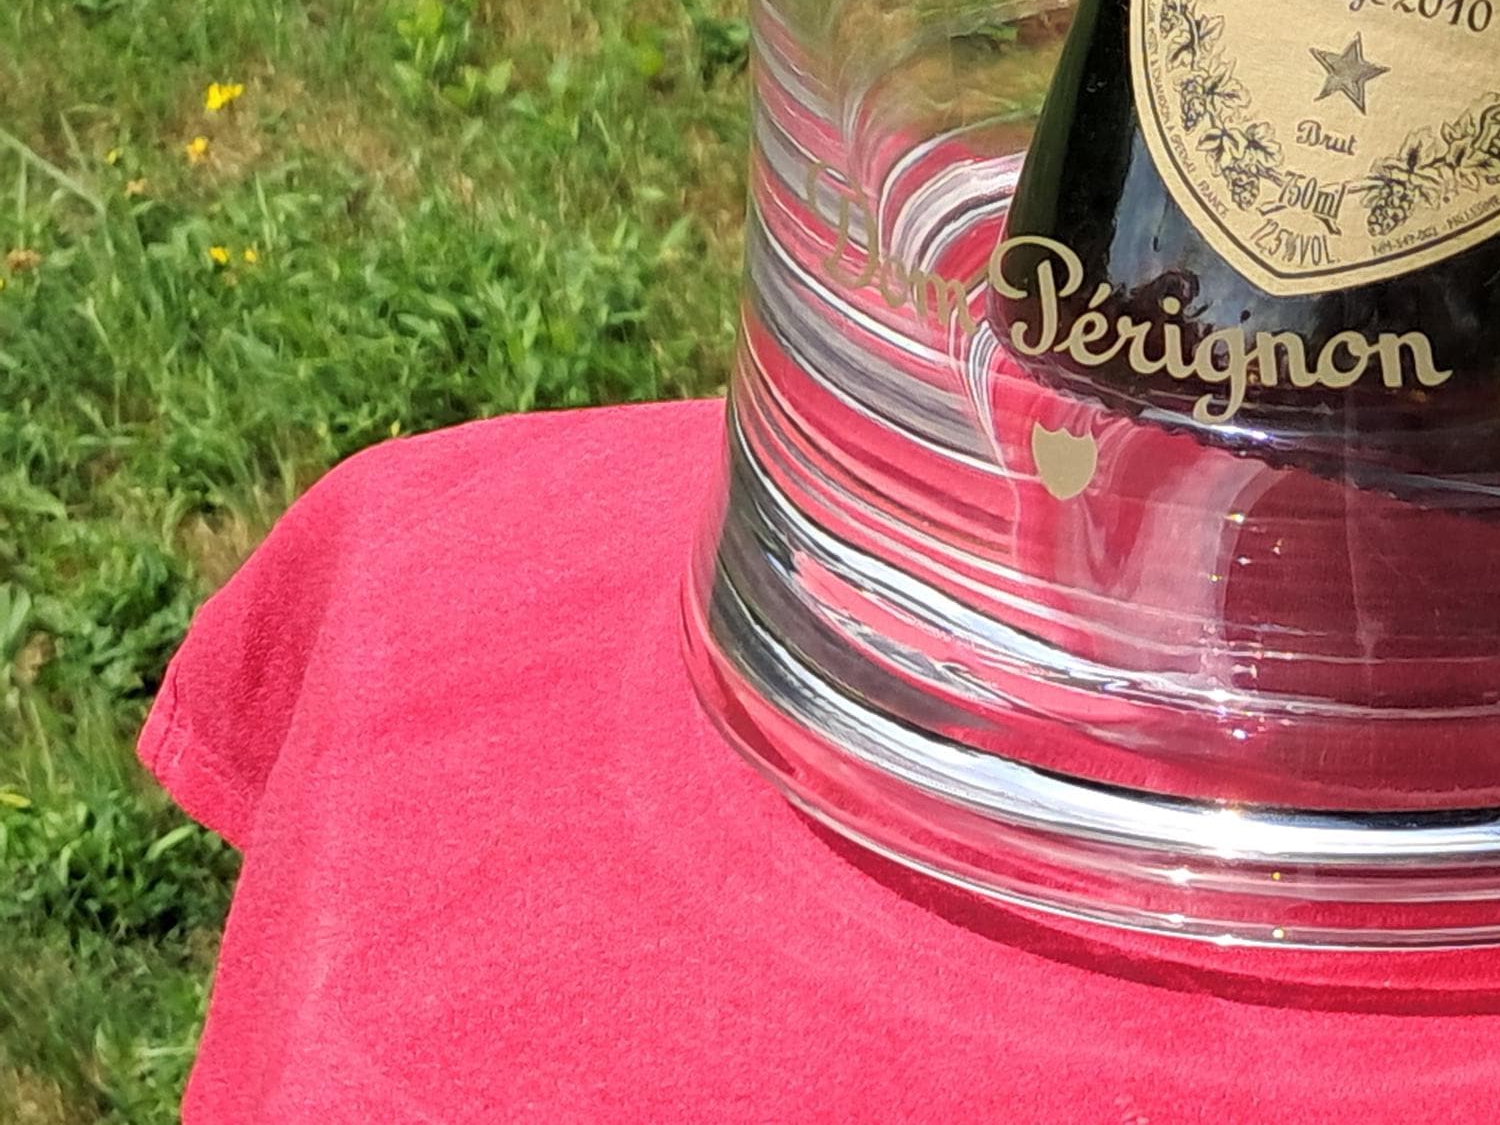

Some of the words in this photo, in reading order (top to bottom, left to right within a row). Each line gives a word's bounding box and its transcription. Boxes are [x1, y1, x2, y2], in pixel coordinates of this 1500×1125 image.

[1296, 119, 1356, 156] Brut
[1279, 170, 1347, 220] 750ml
[988, 235, 1453, 424] Pérignon
